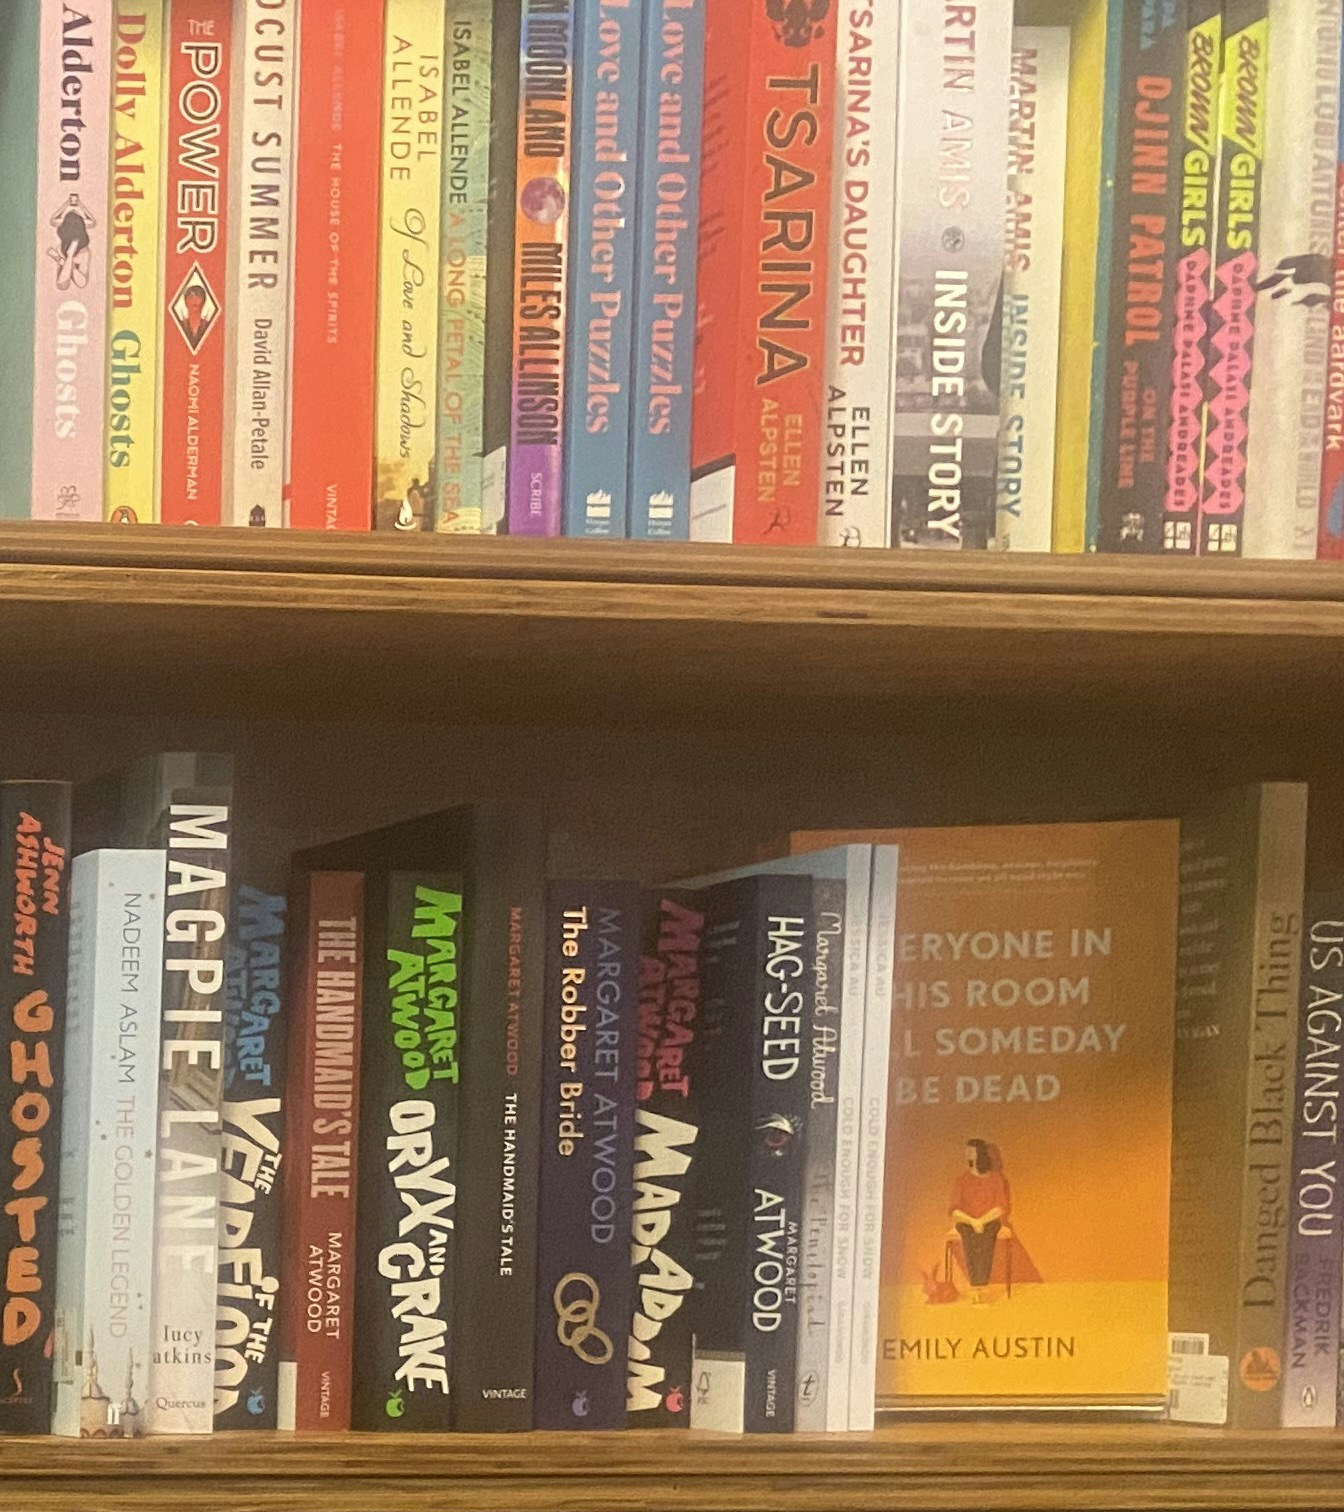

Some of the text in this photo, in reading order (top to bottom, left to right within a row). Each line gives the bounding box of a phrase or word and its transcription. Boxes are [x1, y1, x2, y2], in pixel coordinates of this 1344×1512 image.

[58, 4, 93, 183] Alderton
[176, 42, 223, 255] POWER
[248, 132, 281, 291] SUMMER
[757, 64, 820, 387] TSARINA
[185, 364, 203, 501] NAOMI ALDERMAN
[757, 398, 777, 505] ALPSTEN
[782, 414, 803, 489] ELLEN
[310, 917, 357, 1200] THE HANDMAID'S TALE
[560, 906, 590, 1158] The Robber Bride
[760, 915, 805, 1082] HAG-SEED
[934, 1024, 1128, 1056] SOMEDAY
[965, 976, 1092, 1009] ROOM
[1, 989, 54, 1348] GHOSTED
[955, 1075, 1062, 1103] DEAD
[882, 1336, 1076, 1361] EMILY AUSTIN
